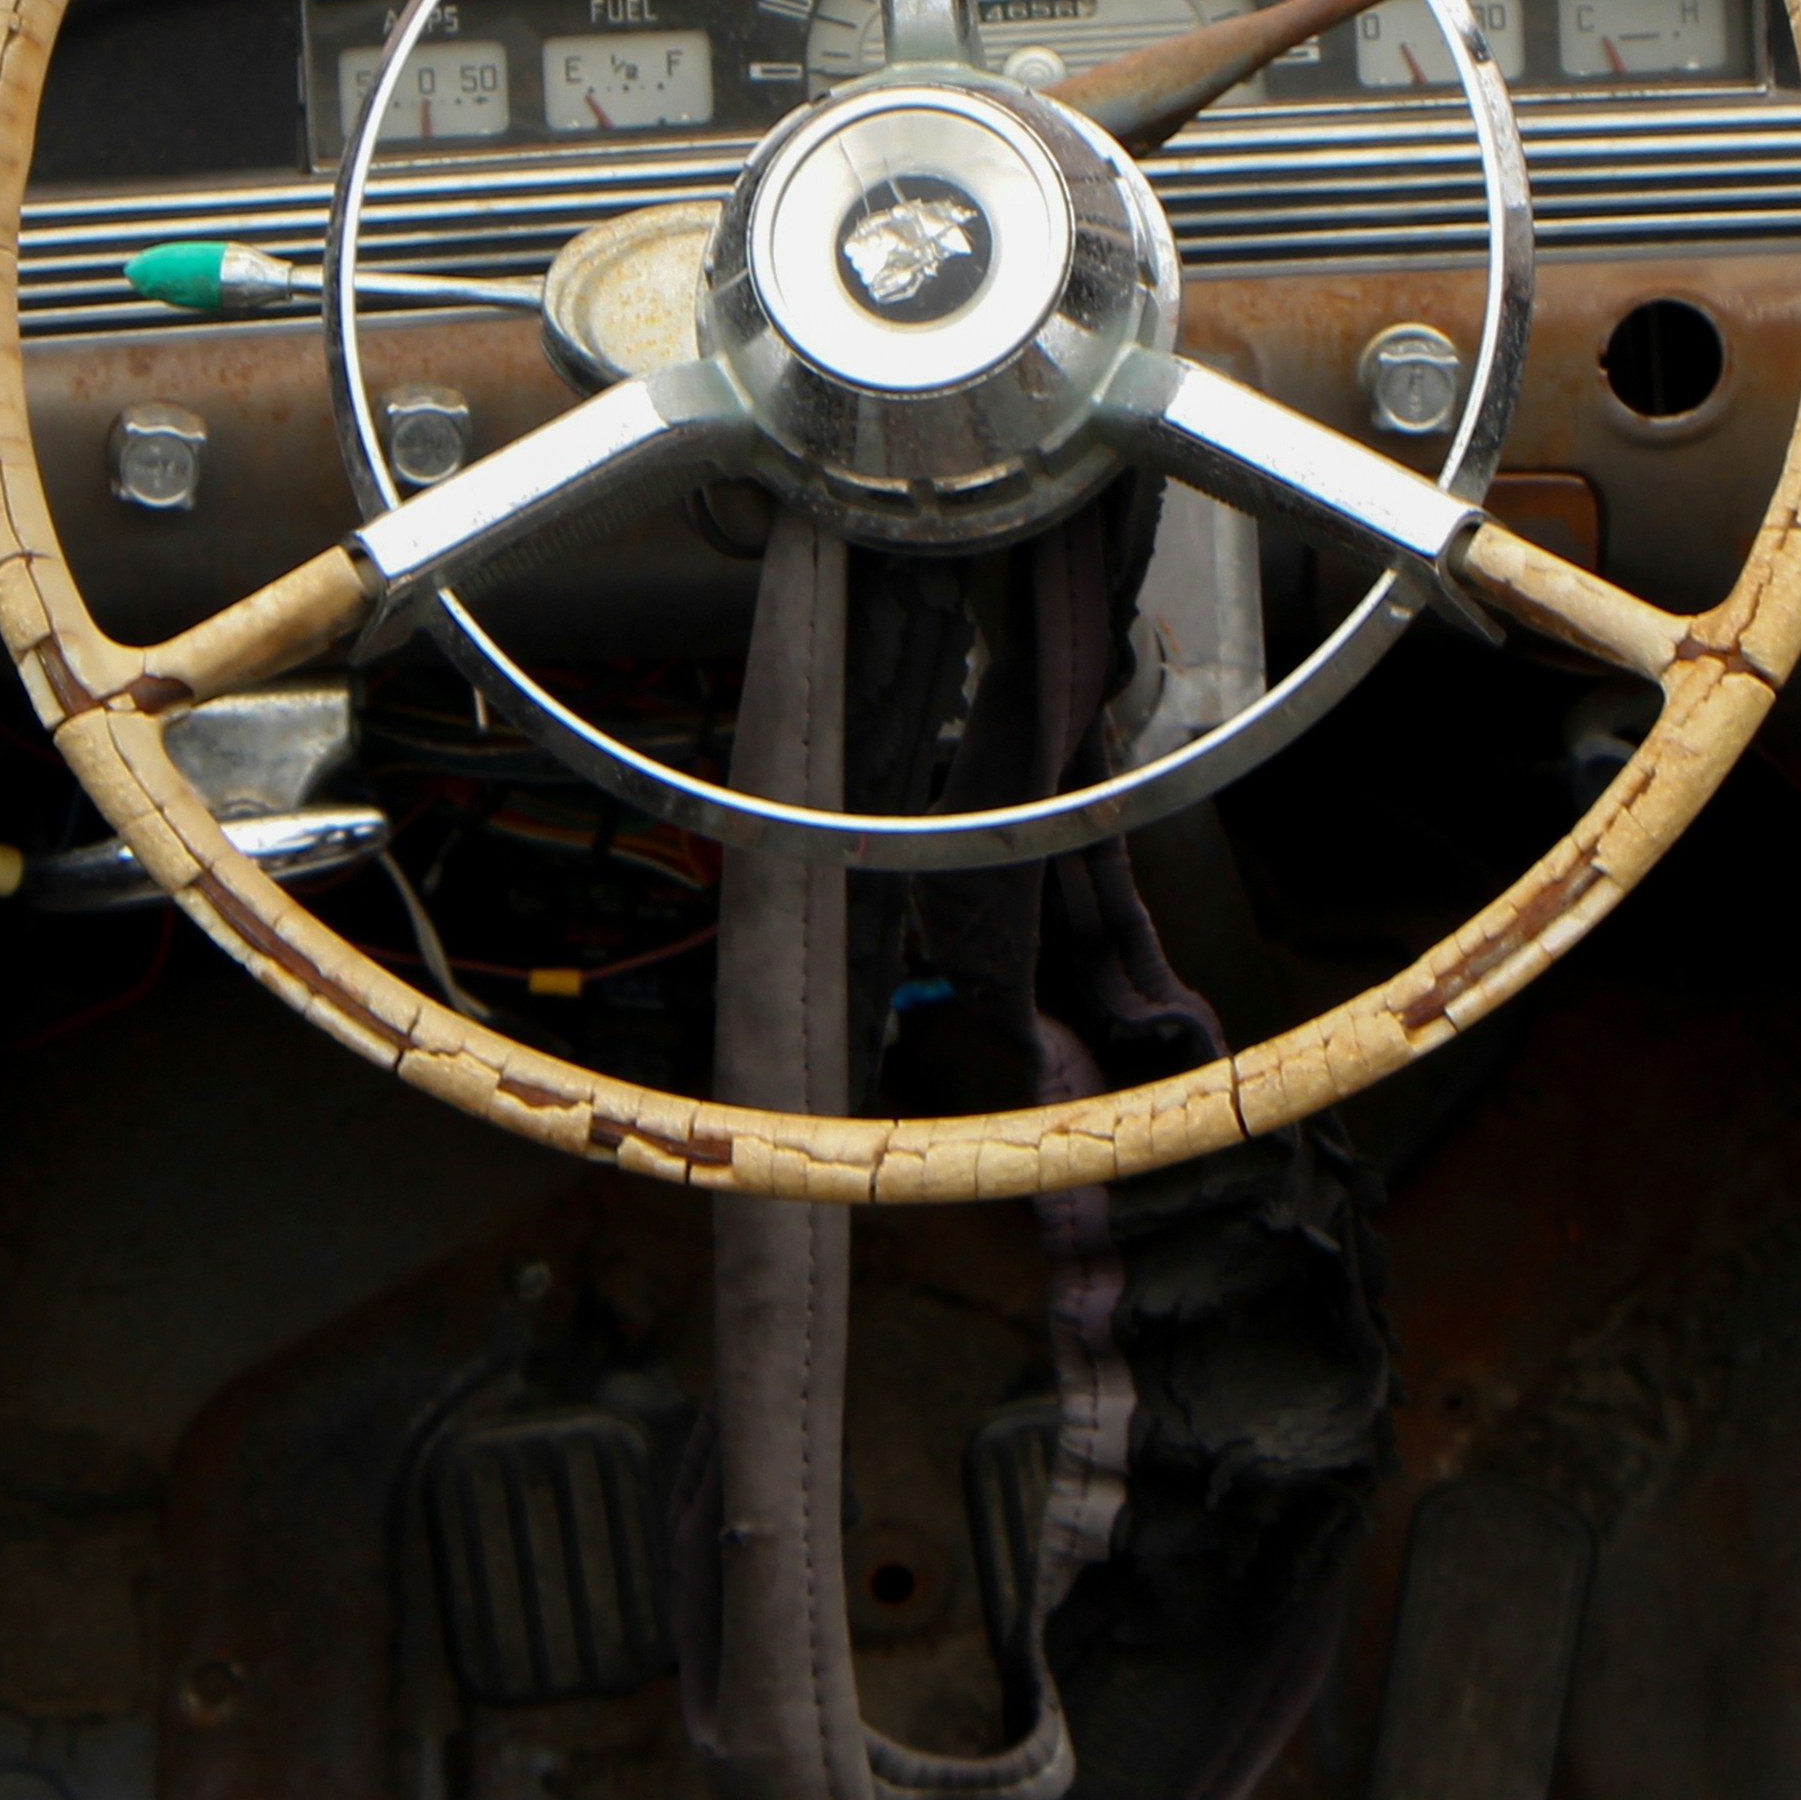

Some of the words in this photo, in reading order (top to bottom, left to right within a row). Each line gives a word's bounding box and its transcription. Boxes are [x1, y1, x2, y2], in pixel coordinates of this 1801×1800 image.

[383, 5, 460, 35] APS
[1362, 12, 1380, 40] 0
[1576, 4, 1595, 33] C
[1680, 0, 1700, 24] H
[417, 66, 435, 95] 0
[460, 64, 498, 92] 50
[564, 55, 583, 84] E
[666, 50, 683, 77] F
